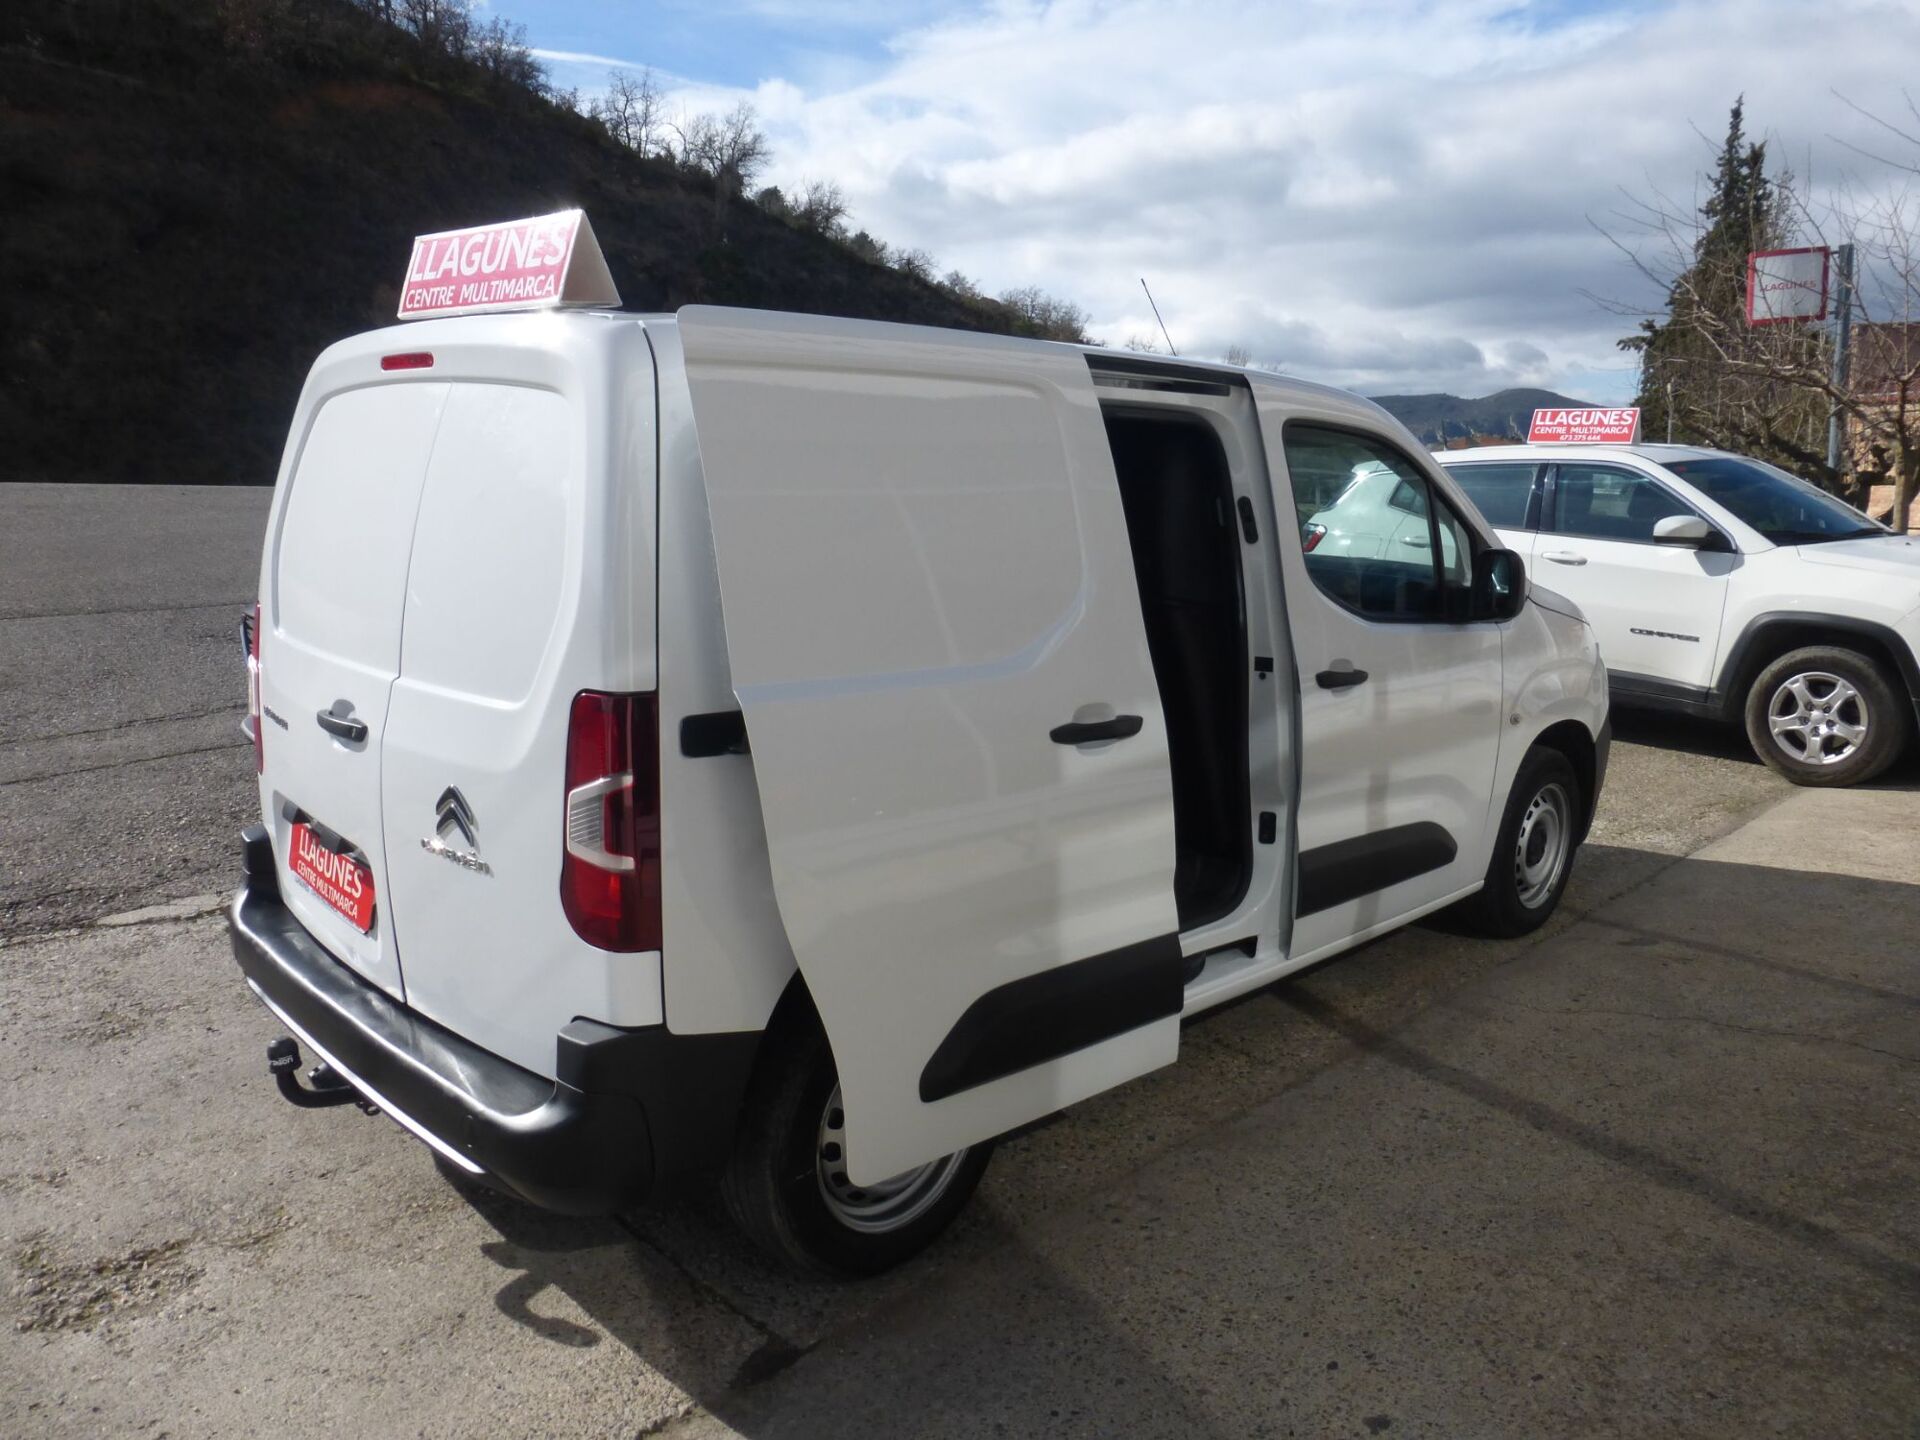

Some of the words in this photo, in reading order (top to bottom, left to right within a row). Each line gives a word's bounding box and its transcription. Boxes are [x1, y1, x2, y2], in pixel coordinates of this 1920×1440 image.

[410, 224, 567, 282] LLAGUNES
[406, 285, 454, 309] CENTRE
[459, 274, 555, 304] MULTIMARCA
[1534, 426, 1566, 434] CENTRE
[1570, 426, 1629, 434] MULTIMARCA
[1535, 411, 1634, 426] LLAGUNES
[299, 828, 364, 898] LLAGUNES
[297, 860, 316, 887] CENTRE
[315, 876, 358, 919] MULTIMARCA
